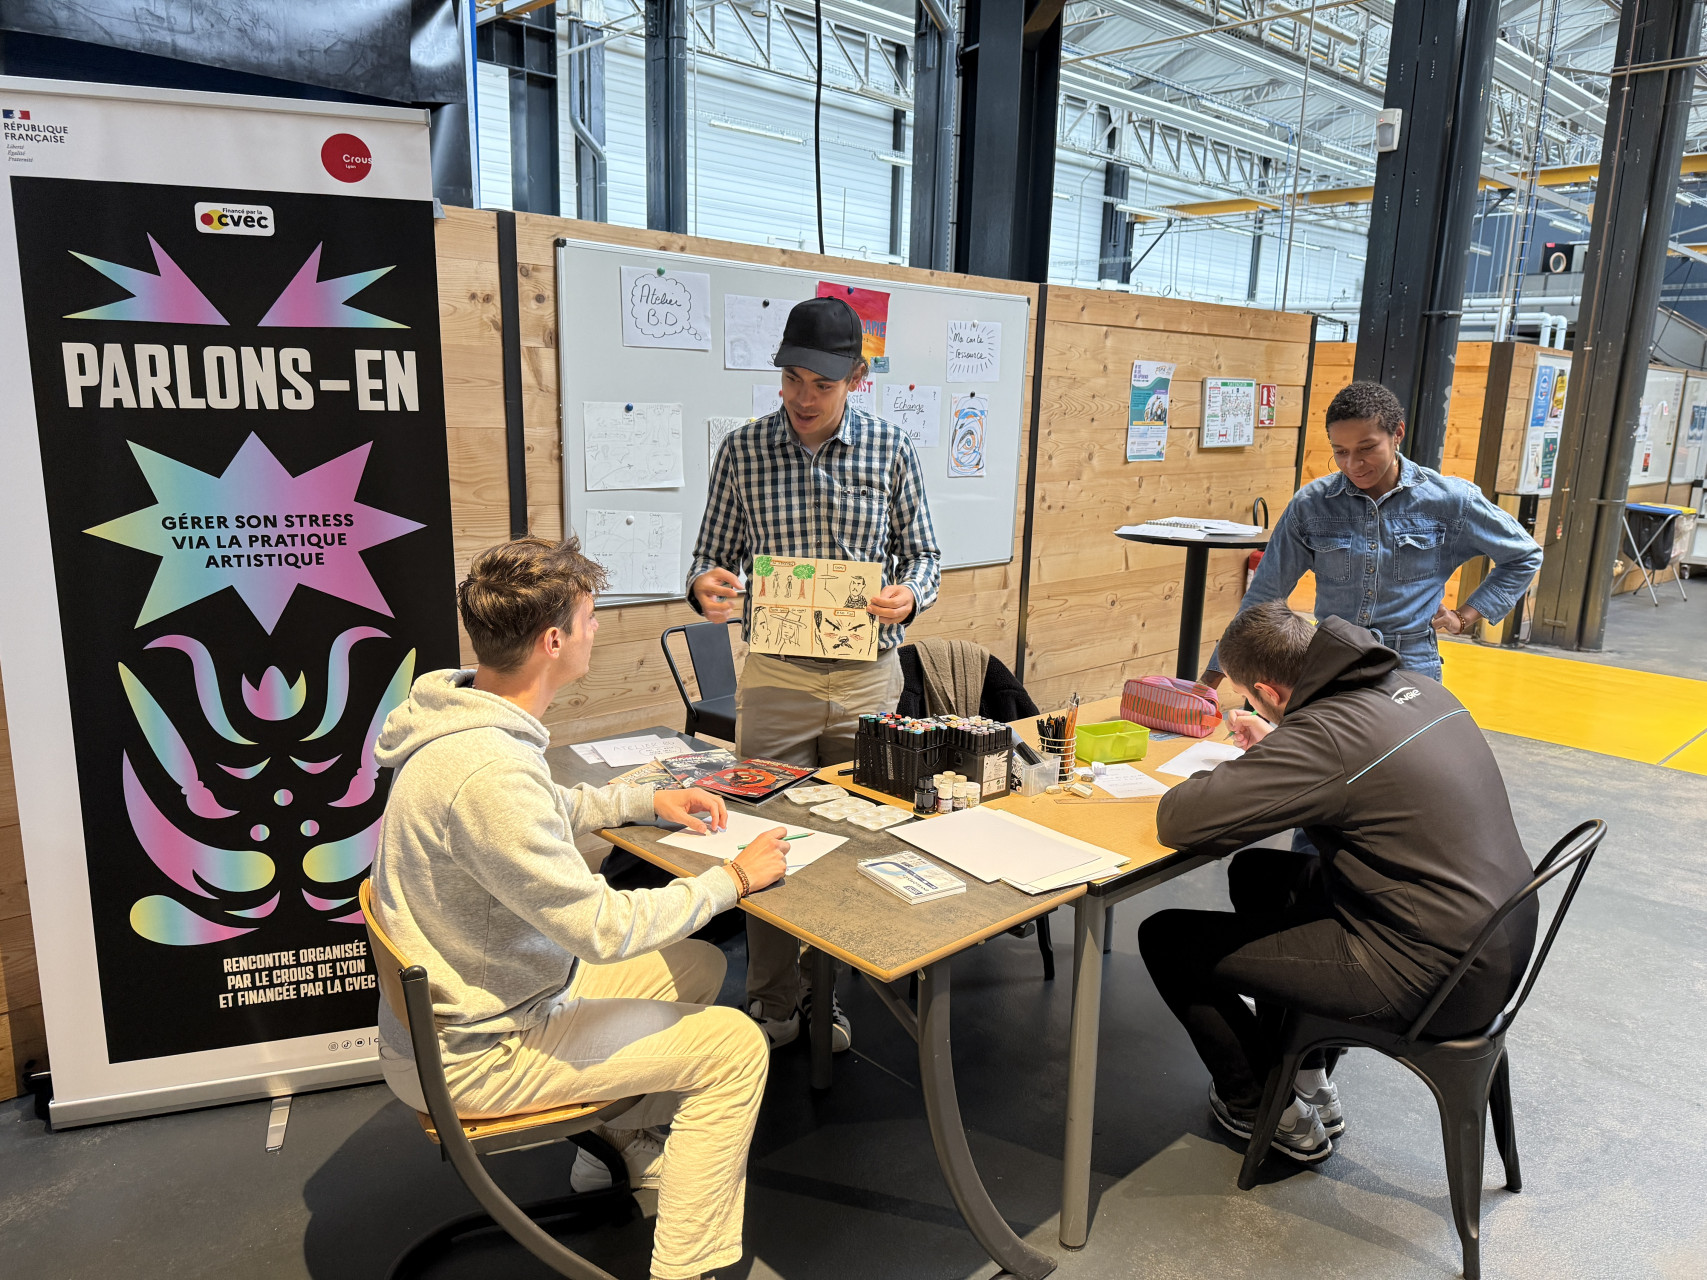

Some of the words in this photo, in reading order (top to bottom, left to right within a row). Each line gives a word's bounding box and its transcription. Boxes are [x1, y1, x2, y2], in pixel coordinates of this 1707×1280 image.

[3, 121, 68, 134] RÉPUBLIQUE
[5, 132, 65, 143] FRANÇAISE
[342, 154, 373, 164] Crous
[217, 213, 269, 229] cvec
[639, 283, 682, 307] Atelier
[161, 512, 230, 530] GÉRER
[235, 514, 278, 529] SON
[284, 513, 354, 528] STRESS
[171, 535, 210, 549] VIA
[216, 535, 242, 549] LA
[248, 533, 347, 549] PRATIQUE
[205, 552, 325, 569] ARTISTIQUE
[223, 950, 297, 973] RENCONTRE
[299, 939, 367, 964] ORGANISÉE
[227, 973, 252, 990] PAR
[255, 970, 270, 987] LE
[273, 964, 315, 984] CROUS
[317, 962, 334, 979] DE
[336, 958, 366, 976] LYON
[219, 993, 234, 1009] ET
[237, 983, 297, 1007] FINANCÉE
[300, 981, 324, 998] PAR
[327, 978, 342, 994] LA
[345, 974, 376, 992] CVEC
